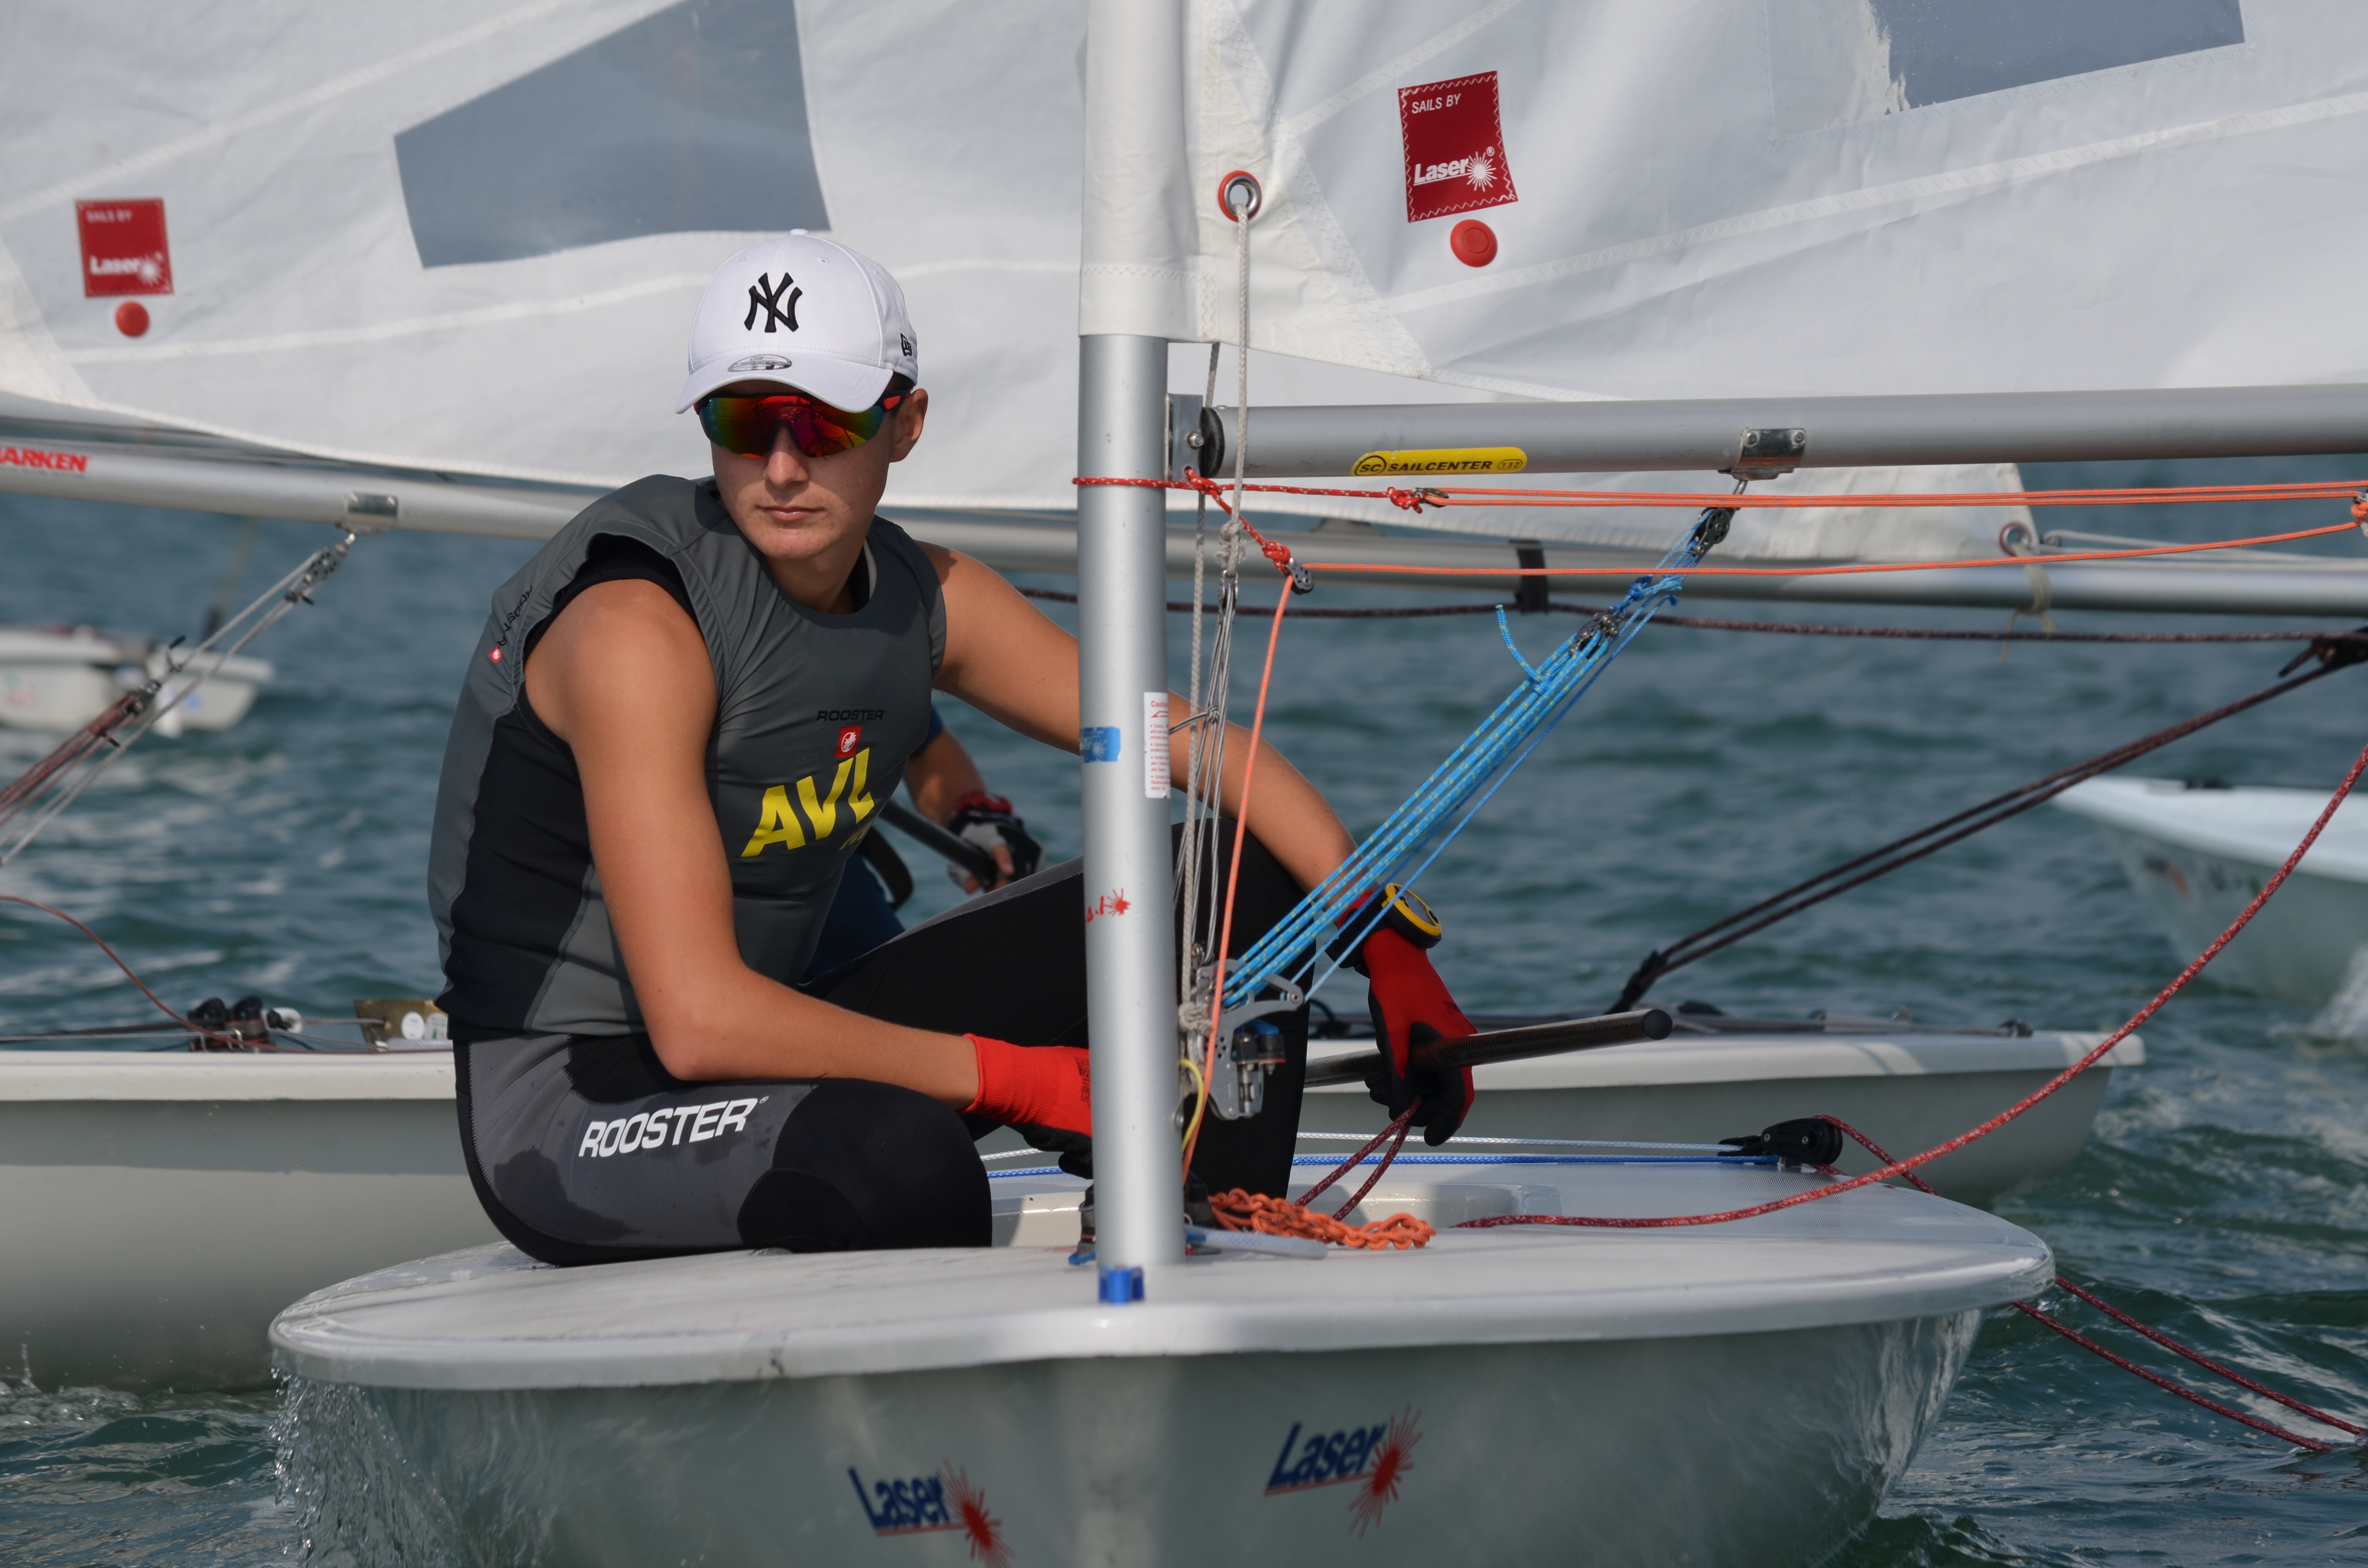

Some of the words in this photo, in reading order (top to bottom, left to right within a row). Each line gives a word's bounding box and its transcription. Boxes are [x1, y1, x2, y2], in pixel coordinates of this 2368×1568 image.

[1412, 97, 1442, 113] SAILS
[1446, 93, 1461, 107] BY
[1414, 158, 1469, 184] Laser
[744, 272, 802, 332] NY
[0, 446, 87, 473] ARKEN
[1359, 464, 1381, 472] SC
[1387, 461, 1492, 472] SAILCENTER
[817, 710, 884, 721] ROOSTER
[1269, 1421, 1387, 1487] Laser
[847, 1468, 950, 1530] Laser
